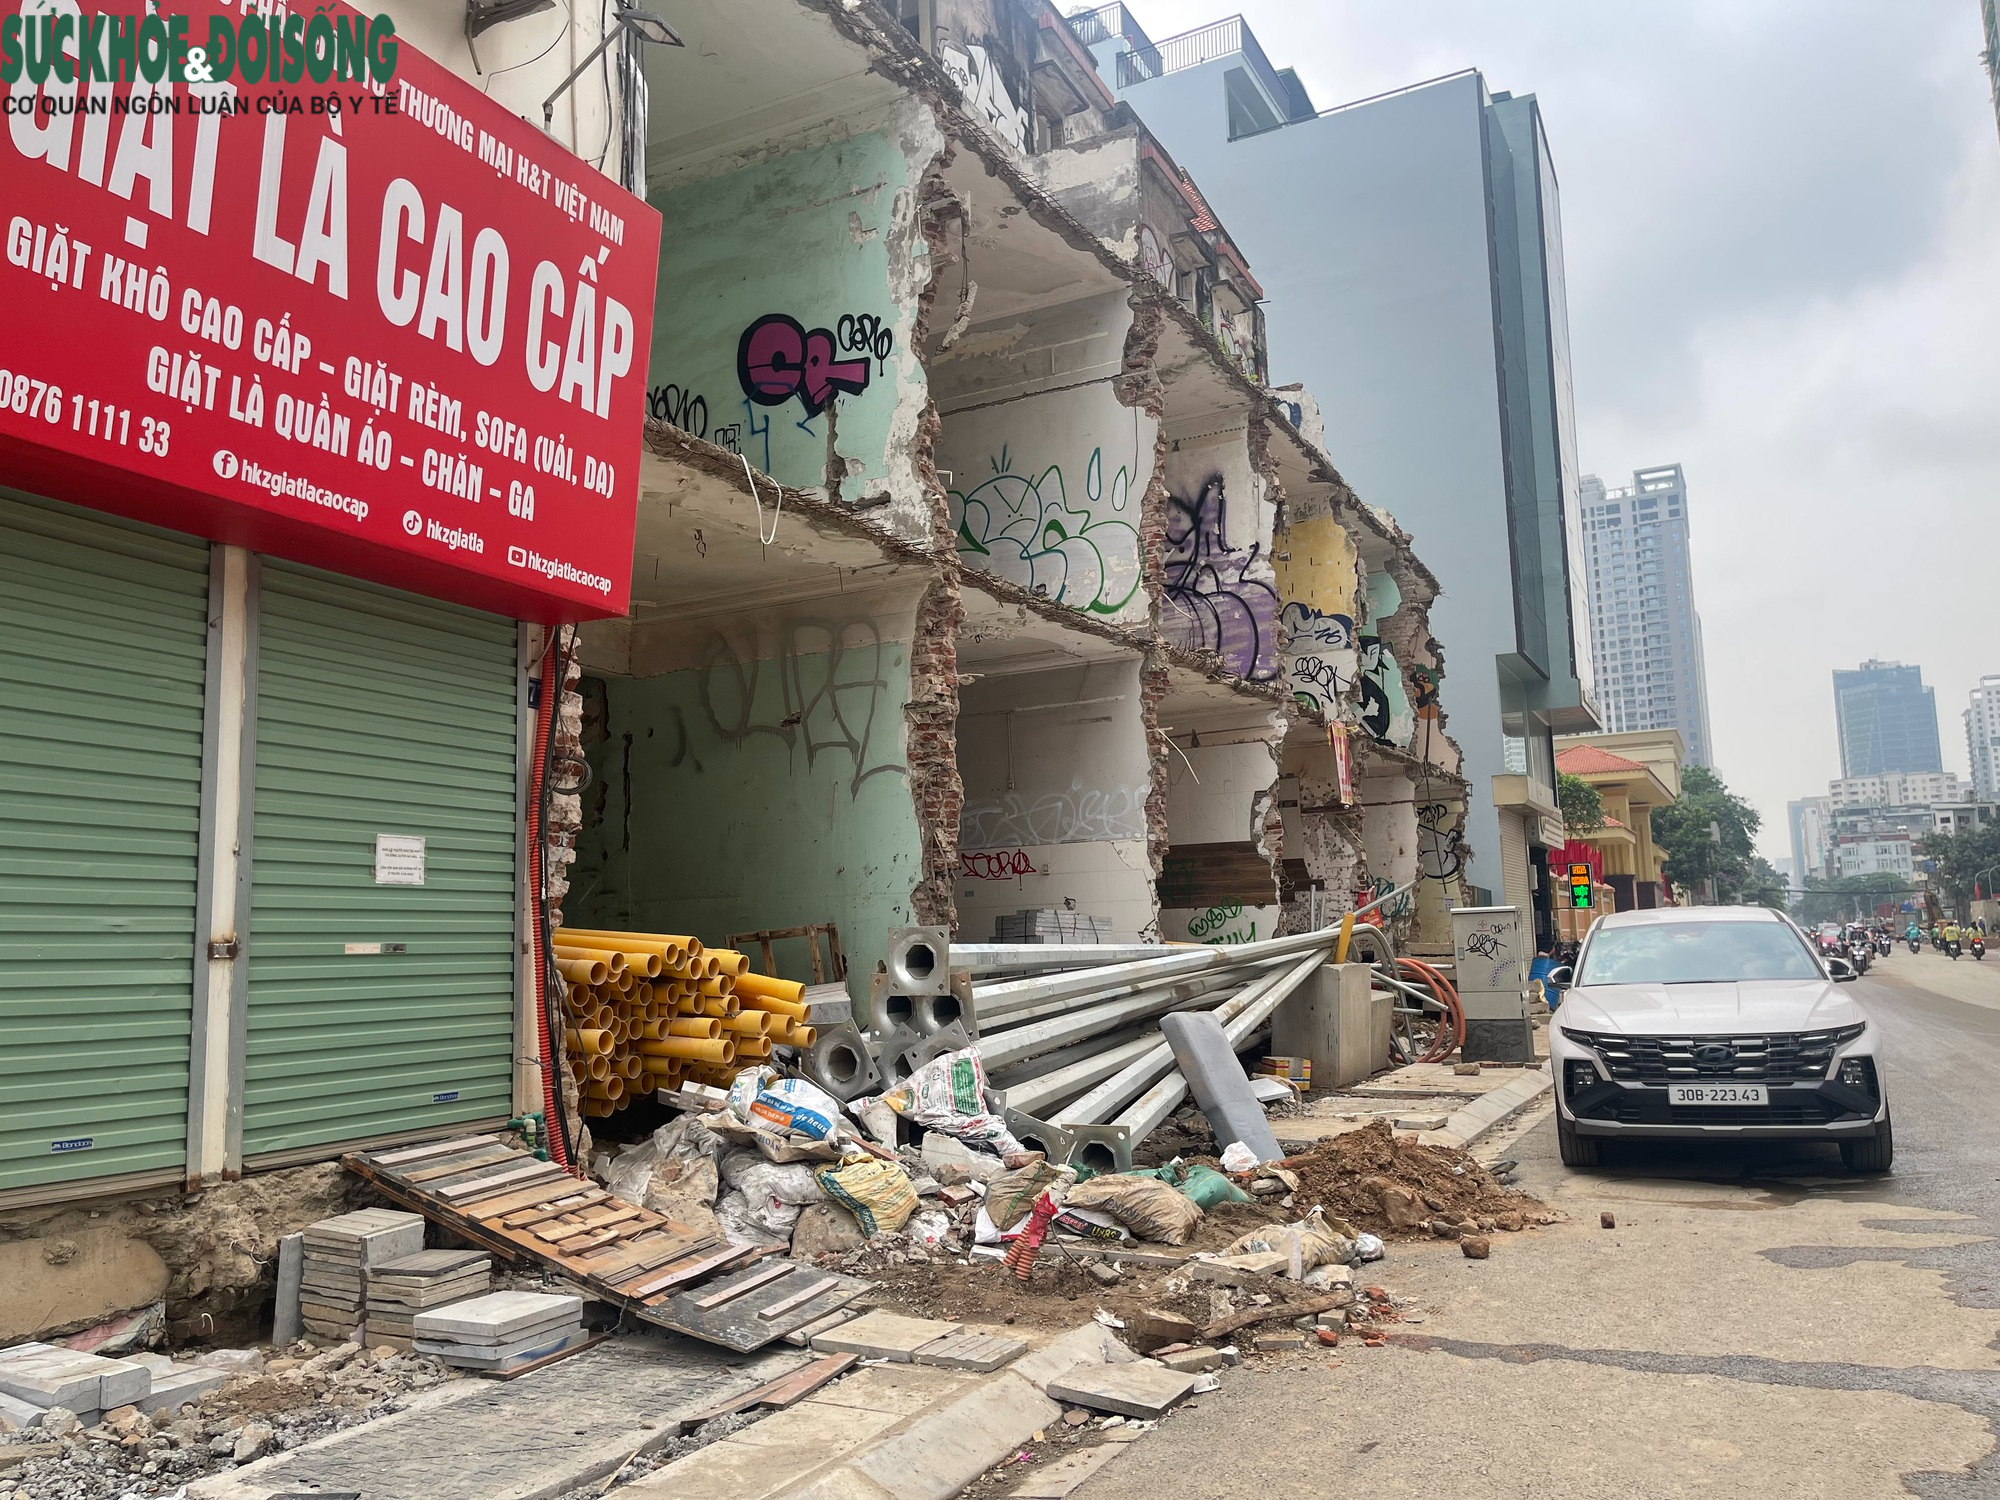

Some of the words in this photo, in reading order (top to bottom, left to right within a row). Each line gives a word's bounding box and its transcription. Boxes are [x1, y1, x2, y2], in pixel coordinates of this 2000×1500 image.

[397, 78, 474, 154] THƯƠNG
[477, 129, 514, 180] MẠI
[516, 153, 552, 200] H&T
[554, 177, 588, 224] VIỆT
[589, 200, 625, 247] NAM
[252, 103, 350, 301] LÀ
[377, 177, 510, 367] CAO
[525, 244, 635, 421] CẤP
[6, 216, 92, 293] GIẶT
[99, 252, 170, 322] KHÔ
[180, 287, 244, 351] CAO
[253, 311, 313, 377] CẤP
[344, 355, 403, 426] GIẶT
[408, 381, 467, 444] RÈM,
[474, 410, 527, 465] SOFA
[533, 435, 578, 487] (VẢI,
[583, 454, 616, 499] DA)
[0, 369, 63, 424] 0876
[72, 394, 131, 446] 1111
[138, 416, 171, 458] 33
[146, 345, 222, 415] GIẶT
[229, 373, 264, 429] LÀ
[274, 391, 351, 459] QUẦN
[357, 417, 393, 472] ÁO
[422, 448, 484, 505] CHĂN
[508, 479, 535, 523] GA
[240, 459, 370, 523] hkzgiatlacaocap
[426, 518, 485, 555] hkzgiatla
[528, 550, 612, 597] hkzgiatlacaocap
[807, 1116, 828, 1134] heus
[1677, 1089, 1760, 1101] 30B-223.43
